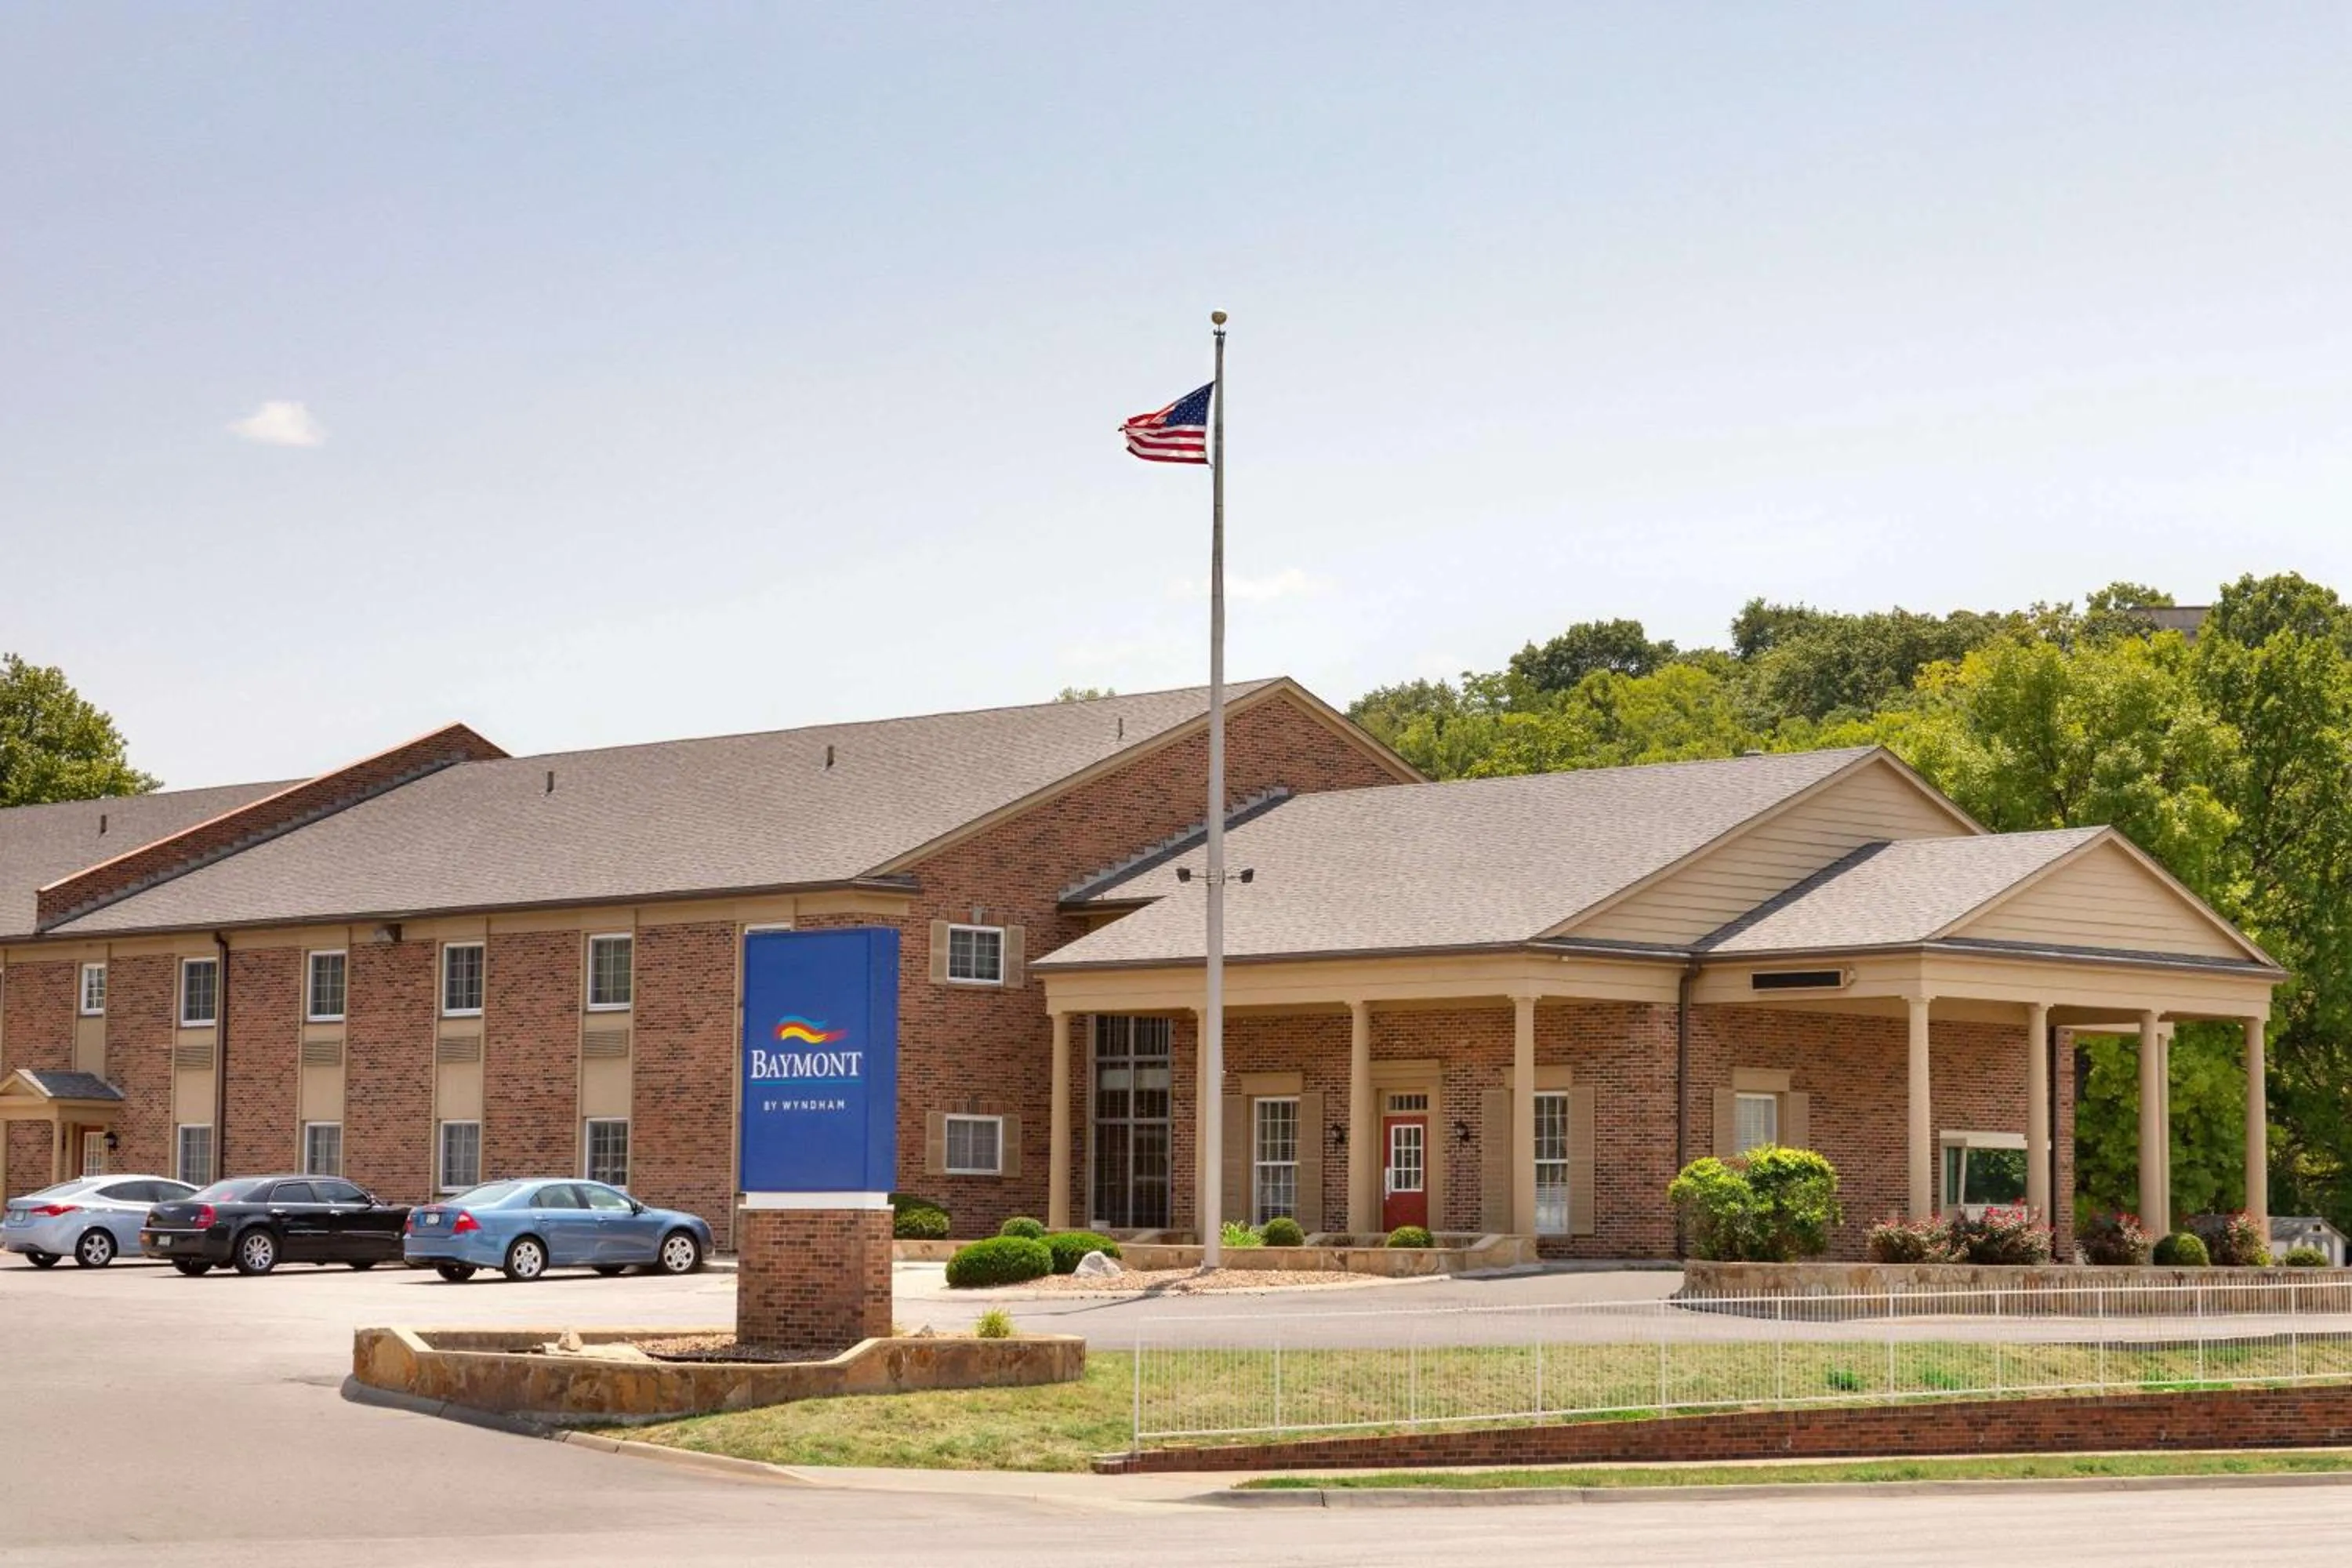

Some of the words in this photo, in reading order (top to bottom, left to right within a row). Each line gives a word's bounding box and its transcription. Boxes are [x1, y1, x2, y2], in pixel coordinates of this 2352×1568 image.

[750, 1050, 862, 1078] BAYMONT
[764, 1100, 777, 1111] BY
[782, 1099, 844, 1111] WYNDHAM
